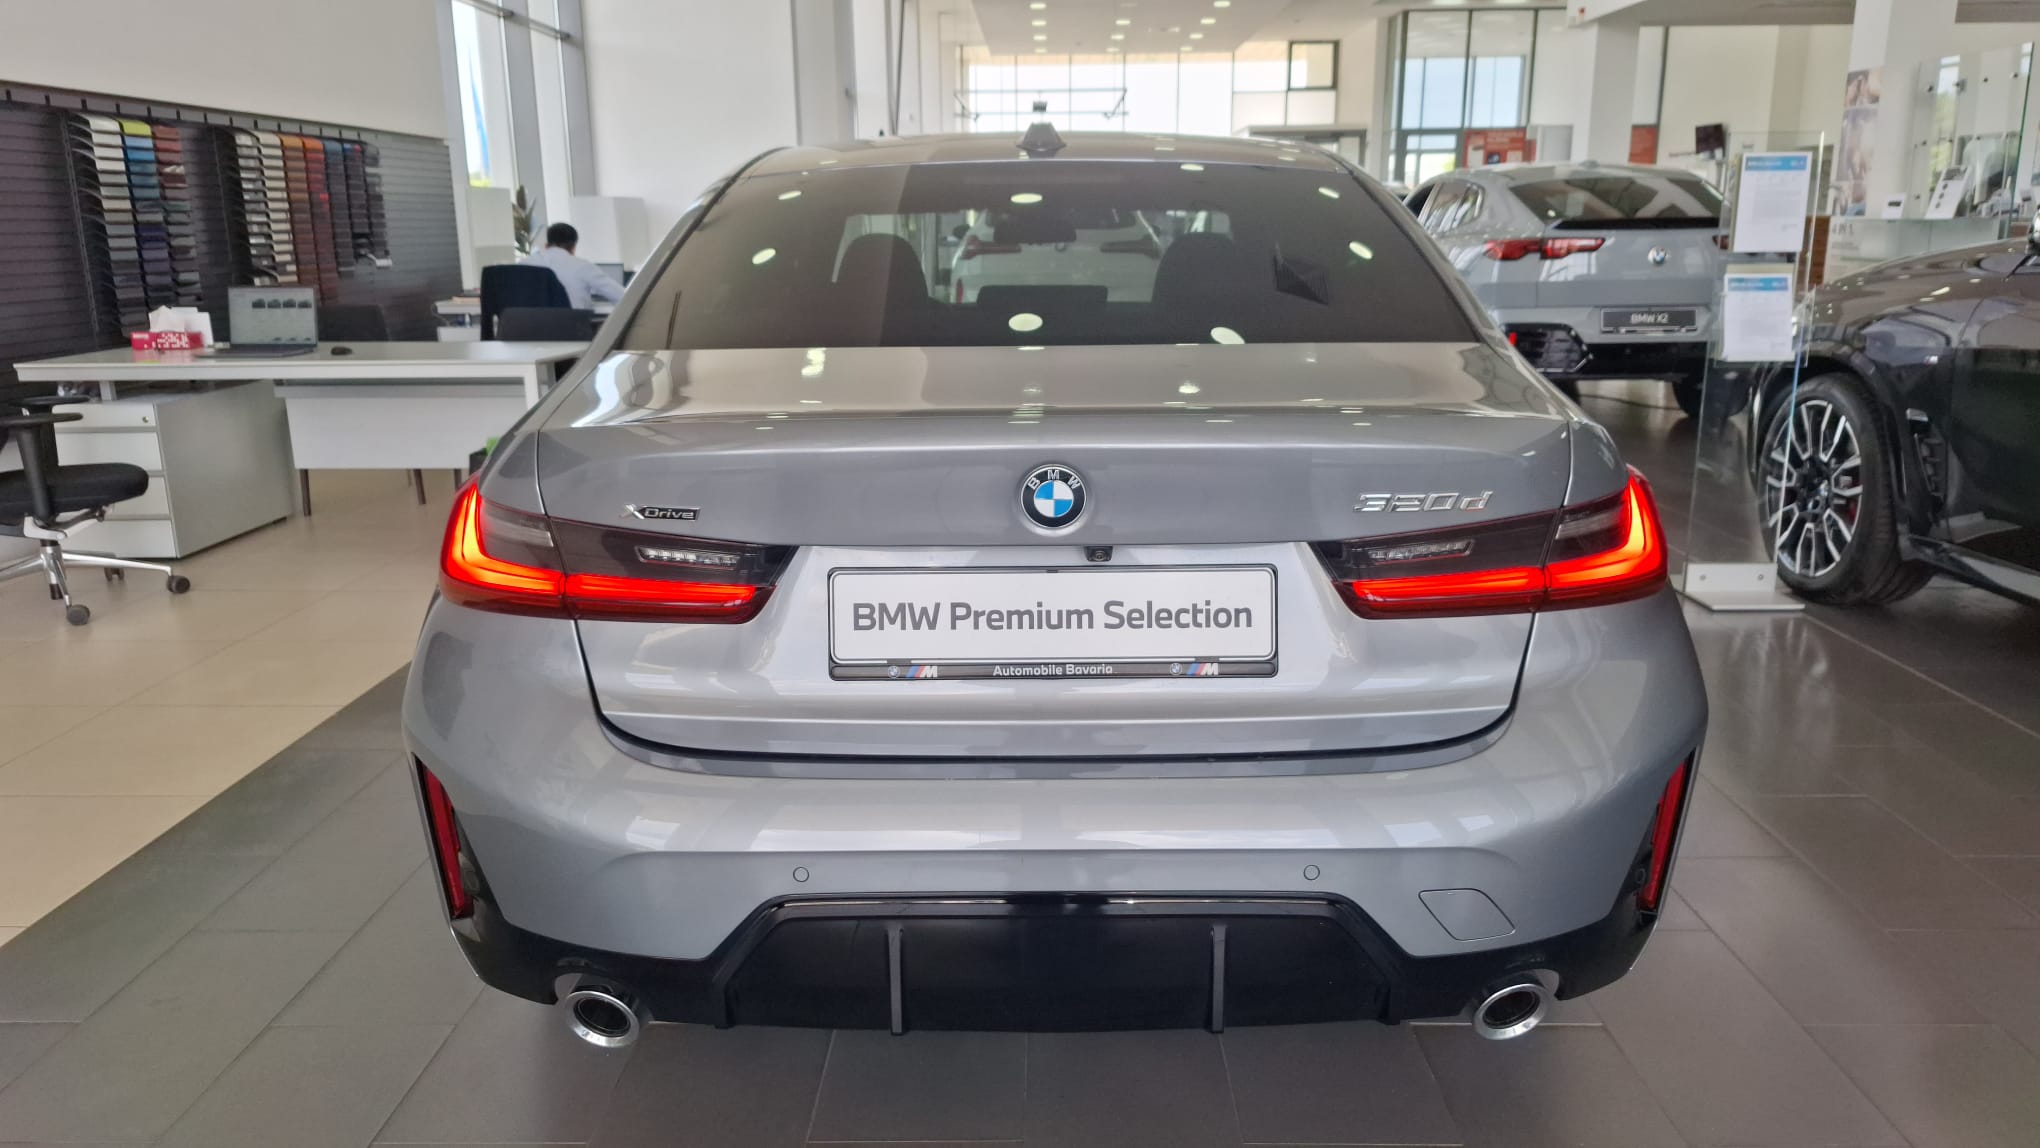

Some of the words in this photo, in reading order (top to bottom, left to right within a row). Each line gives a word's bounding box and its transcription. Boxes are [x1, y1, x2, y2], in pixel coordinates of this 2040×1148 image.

[1630, 313, 1655, 324] BMW
[1027, 469, 1081, 490] BMW
[1353, 491, 1494, 512] 320d
[853, 602, 941, 631] BMW
[950, 601, 1094, 630] Premium
[1103, 599, 1253, 630] Selection
[992, 664, 1063, 677] Automobile
[1065, 663, 1113, 675] Bavaria
